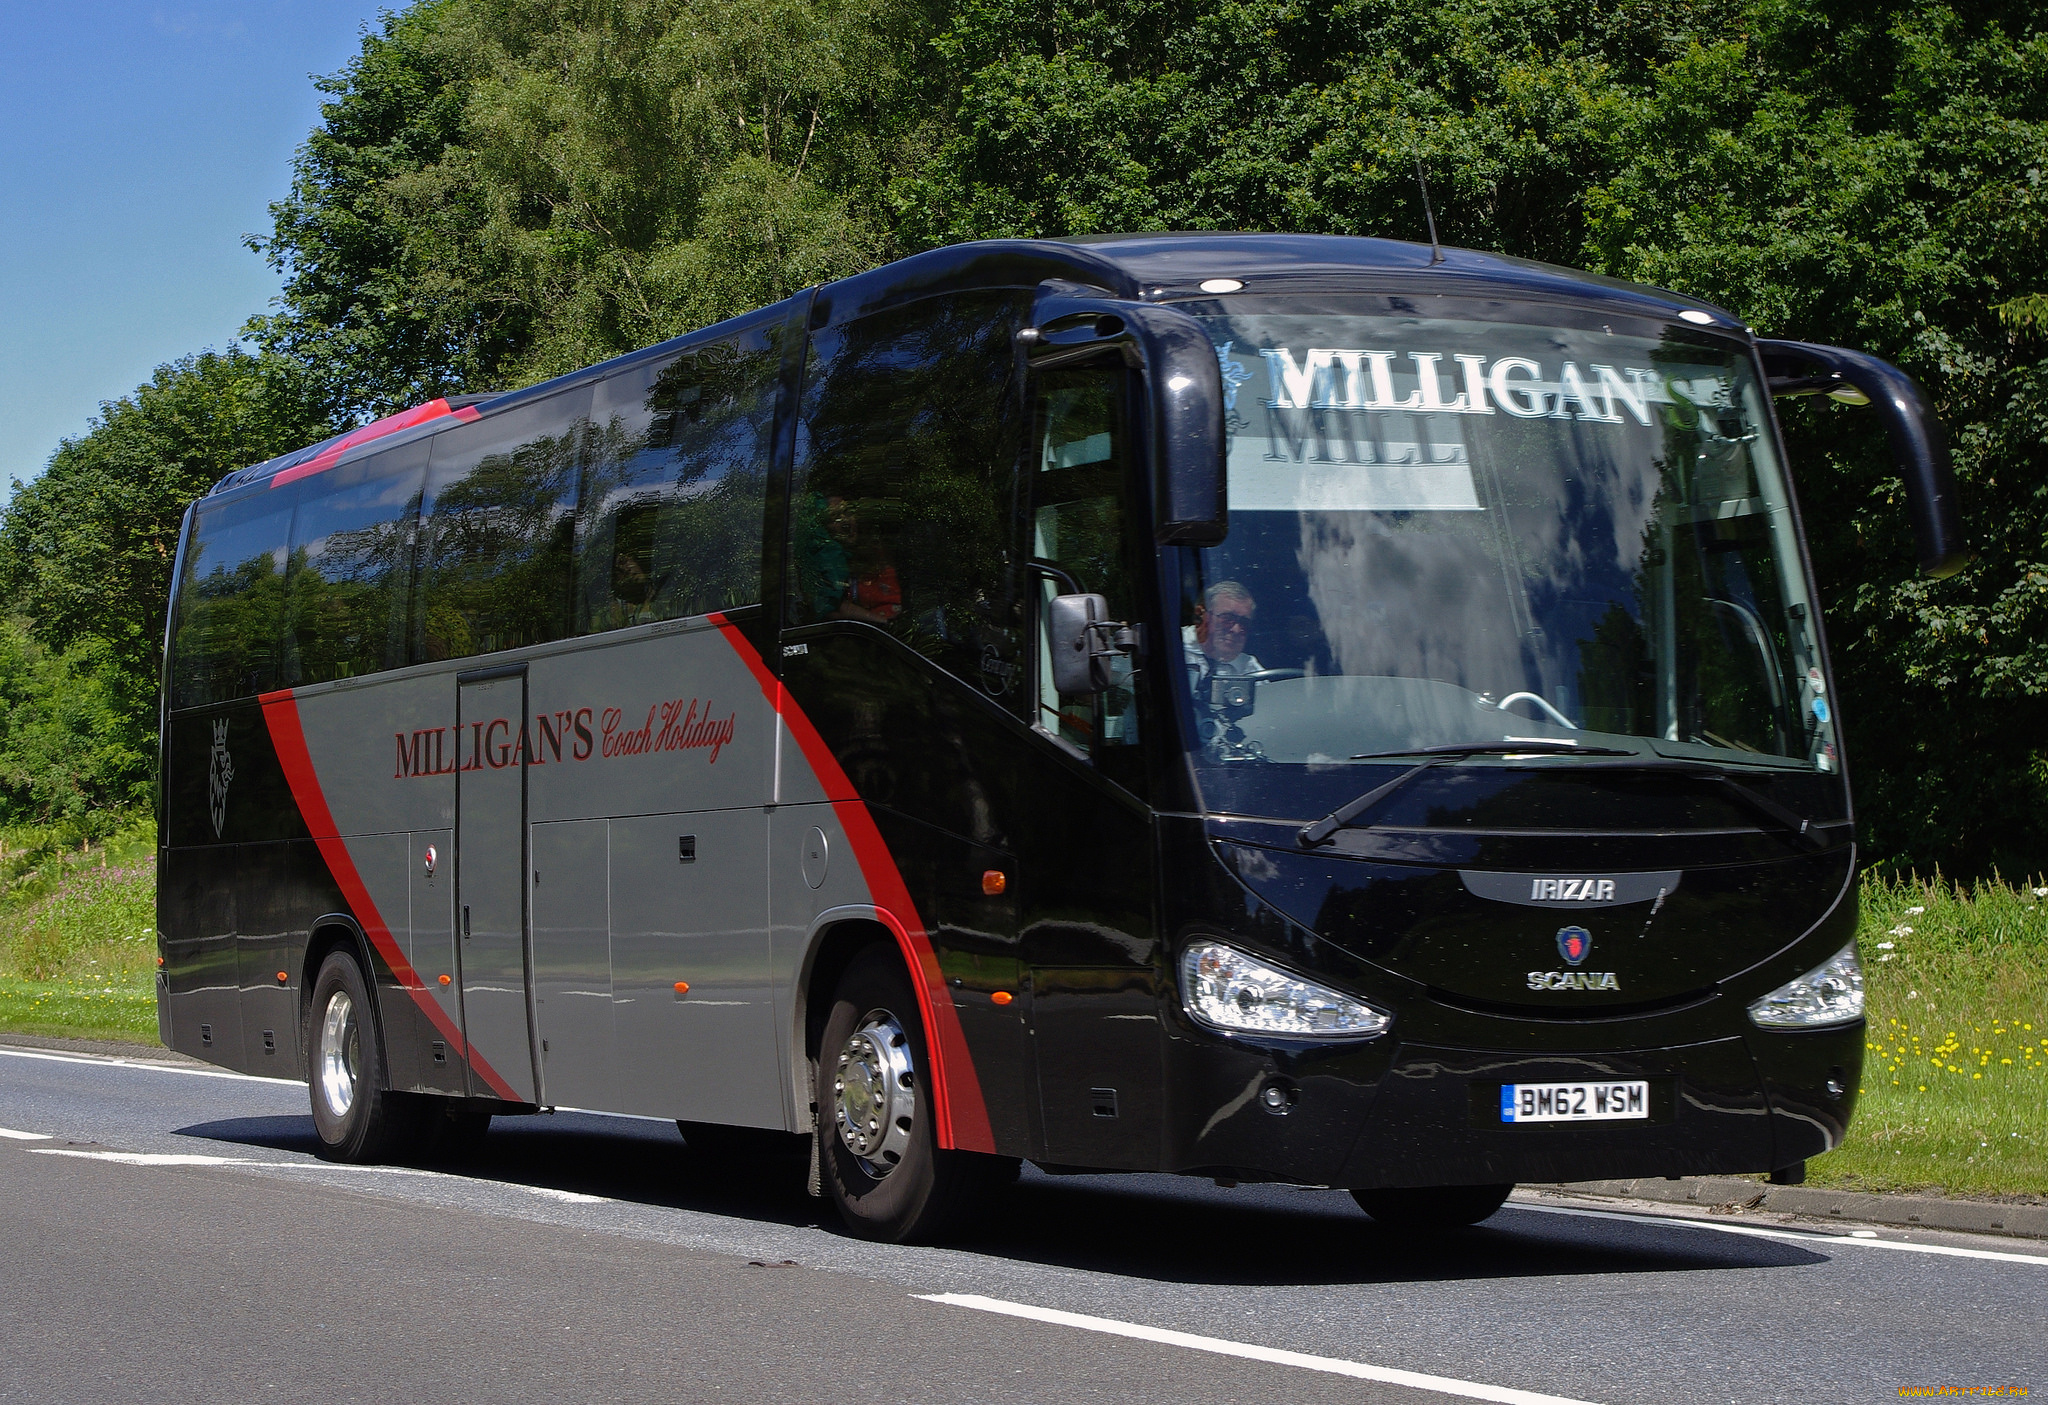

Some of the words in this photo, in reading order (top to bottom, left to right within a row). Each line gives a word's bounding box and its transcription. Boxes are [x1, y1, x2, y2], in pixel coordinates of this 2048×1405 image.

[394, 707, 594, 779] MILLIGAN'S
[601, 703, 657, 758] Coach
[655, 698, 736, 764] Holidays
[1530, 879, 1617, 901] IRIZAR
[1526, 971, 1621, 991] SCANIA
[1519, 1086, 1587, 1117] BM62
[1594, 1085, 1643, 1113] WSM
